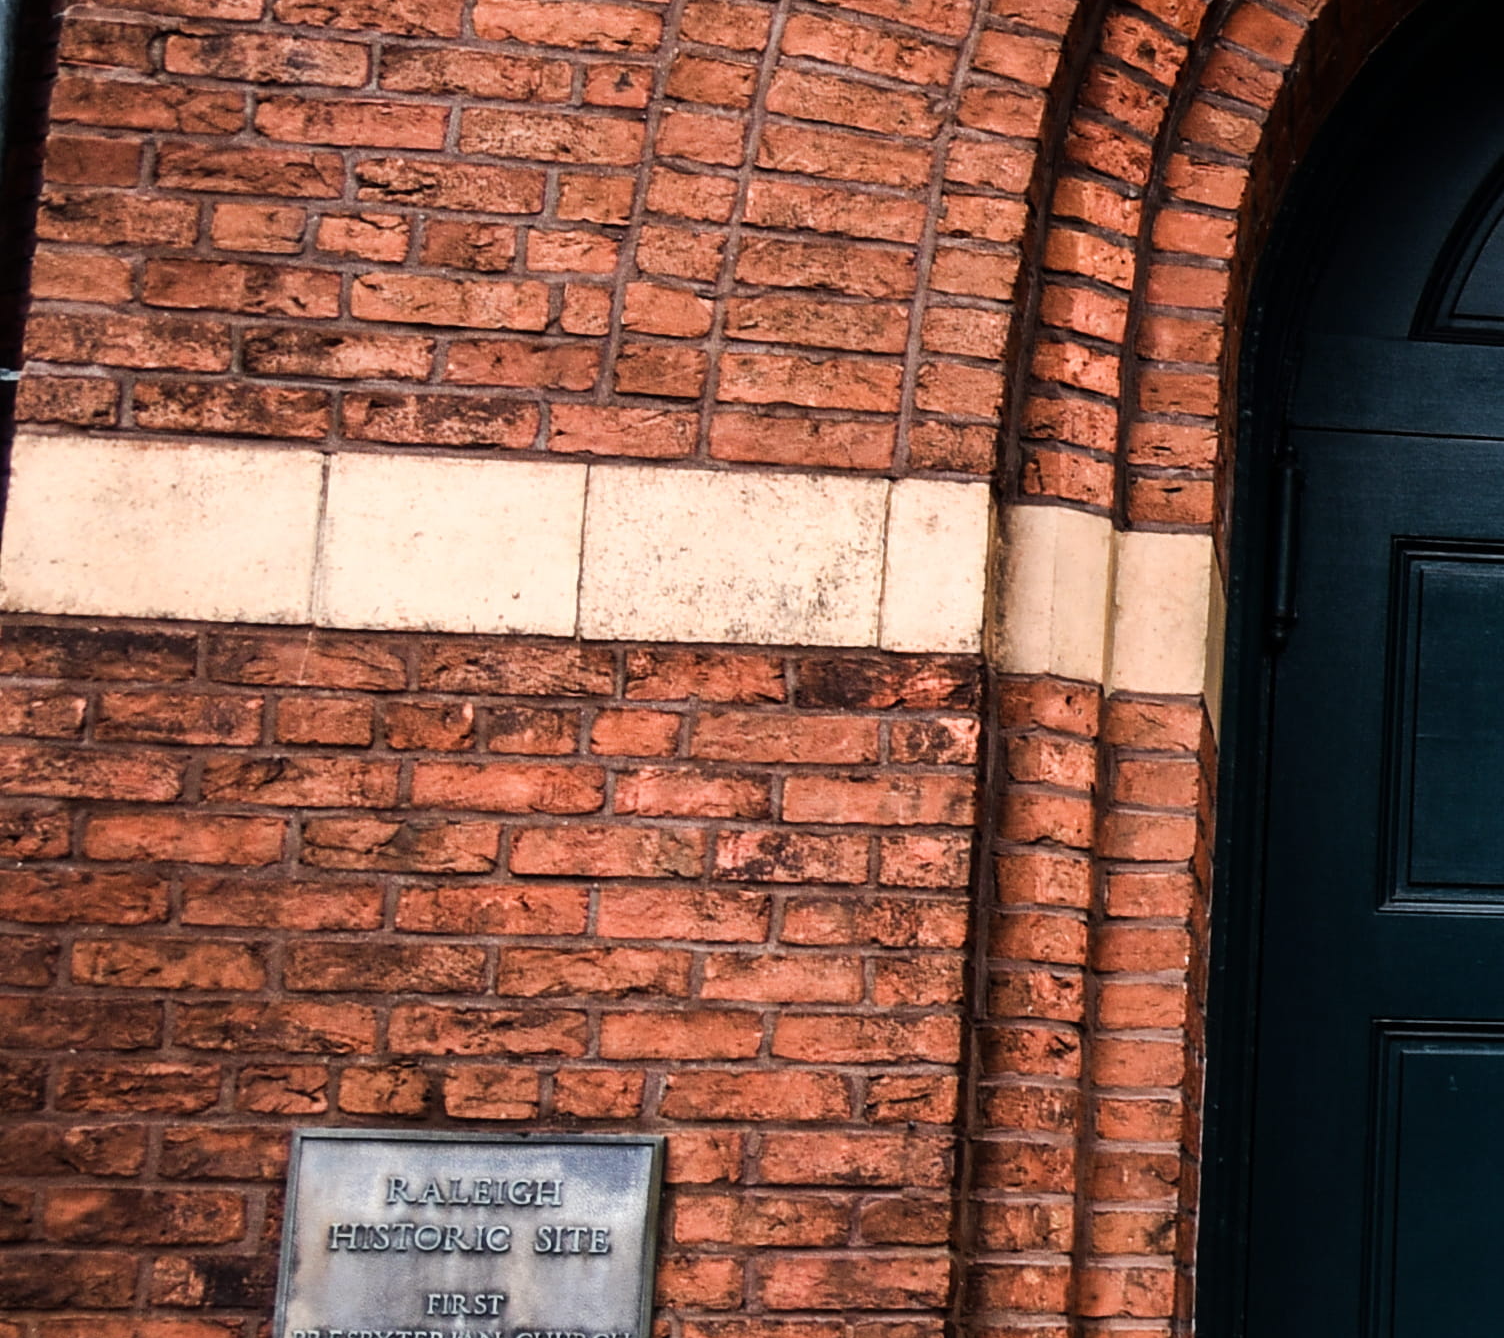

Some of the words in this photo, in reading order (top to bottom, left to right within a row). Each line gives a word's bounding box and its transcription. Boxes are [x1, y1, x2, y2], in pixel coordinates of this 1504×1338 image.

[386, 1177, 564, 1207] RALEIGH
[328, 1222, 511, 1252] HISTORIC
[534, 1225, 610, 1254] SITE
[426, 1293, 505, 1315] FIRST
